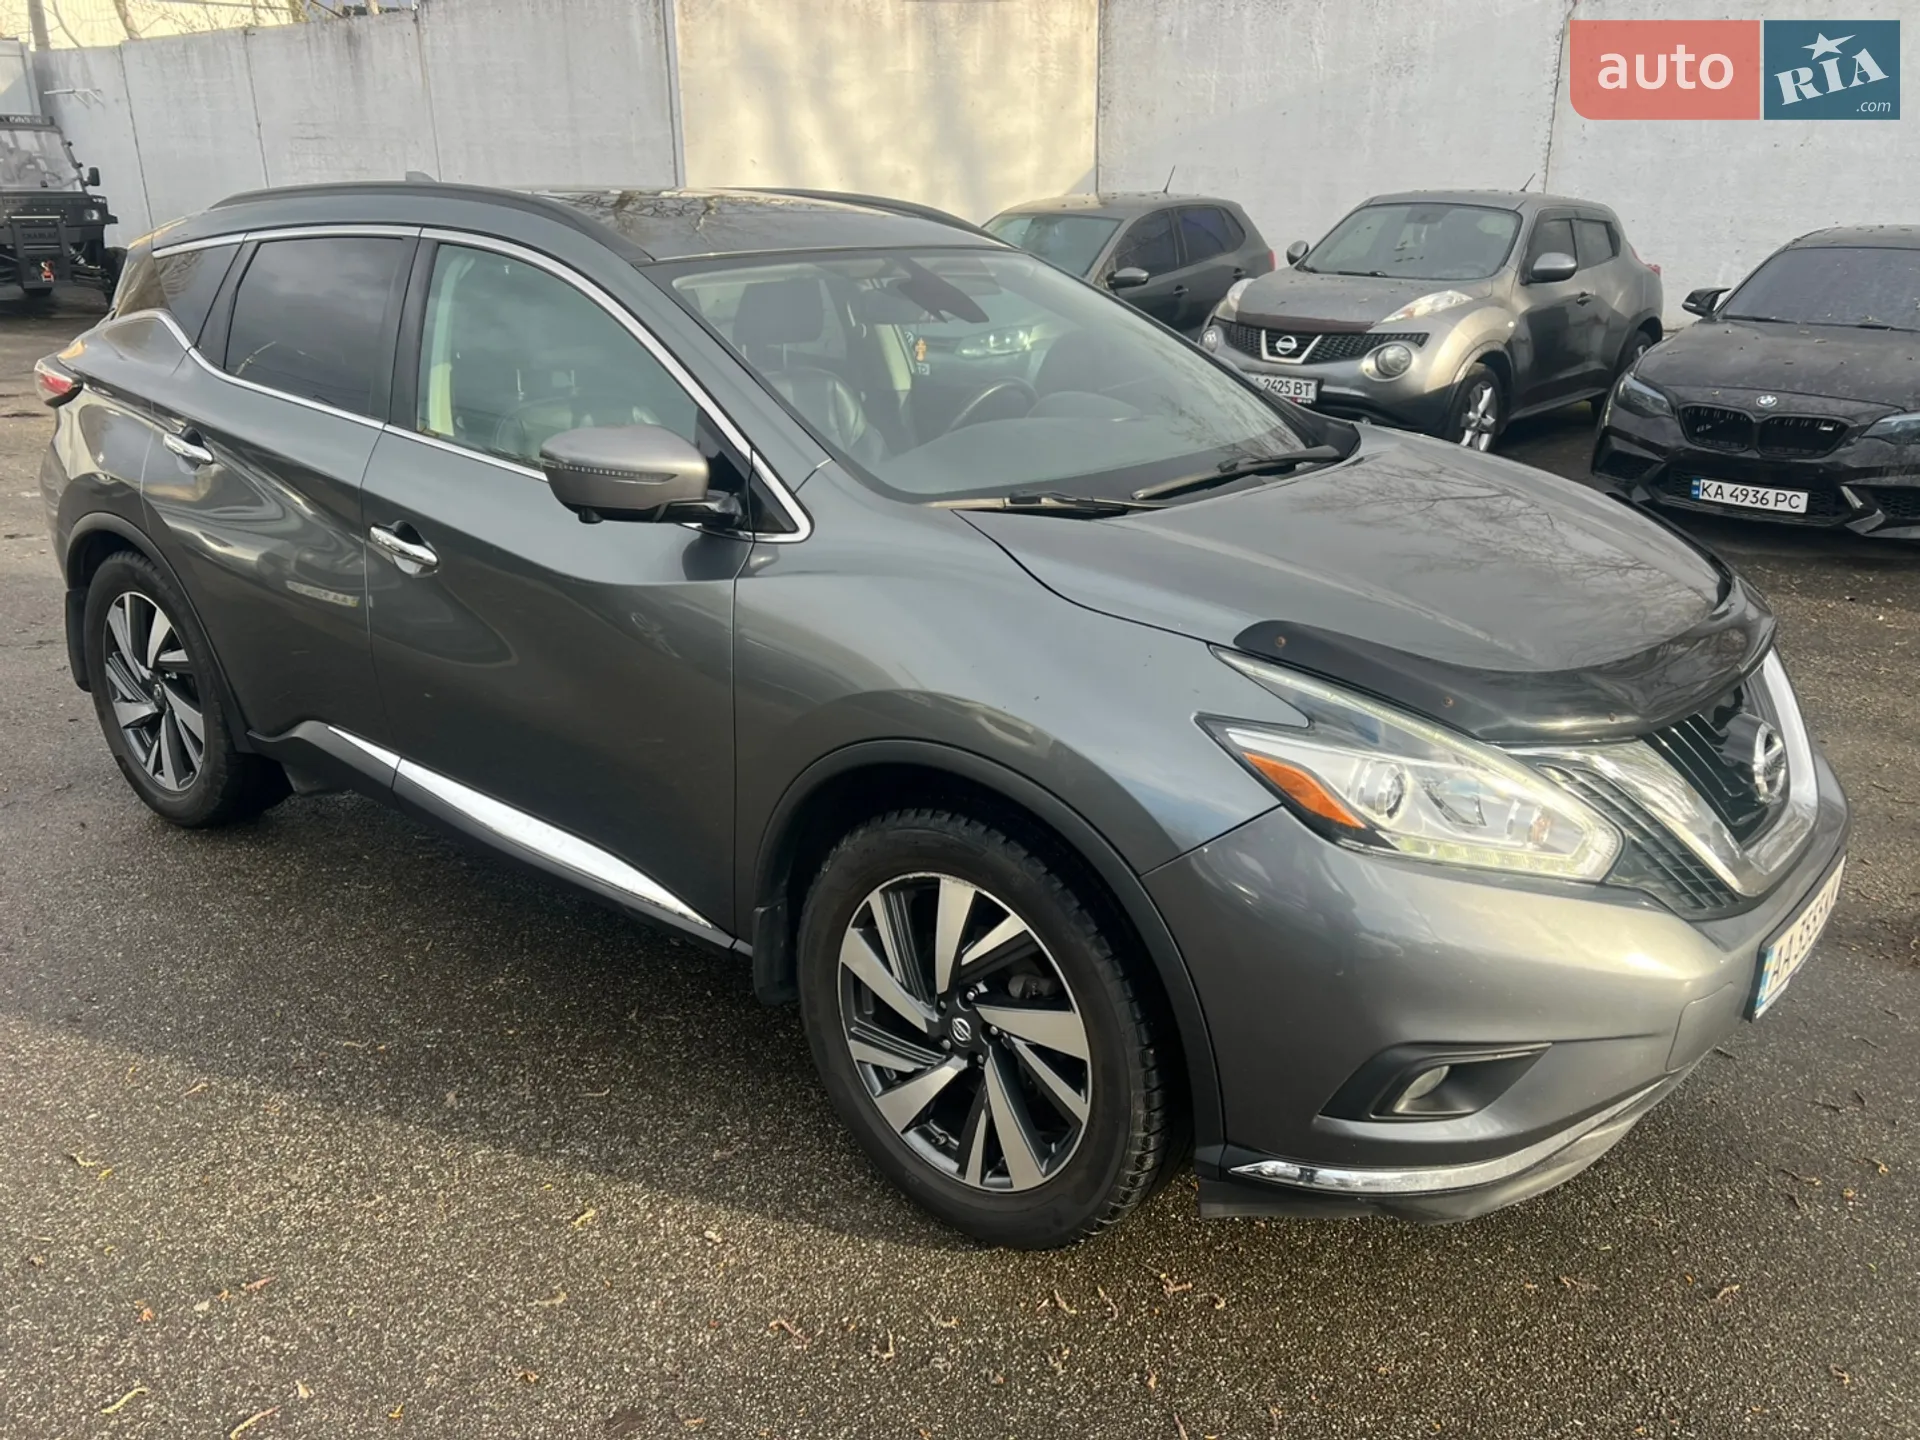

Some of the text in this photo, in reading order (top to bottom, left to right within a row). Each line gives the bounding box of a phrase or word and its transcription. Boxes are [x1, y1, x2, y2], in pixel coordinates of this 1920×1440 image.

[1294, 381, 1312, 396] BT
[1701, 481, 1801, 509] KA 4936 PC
